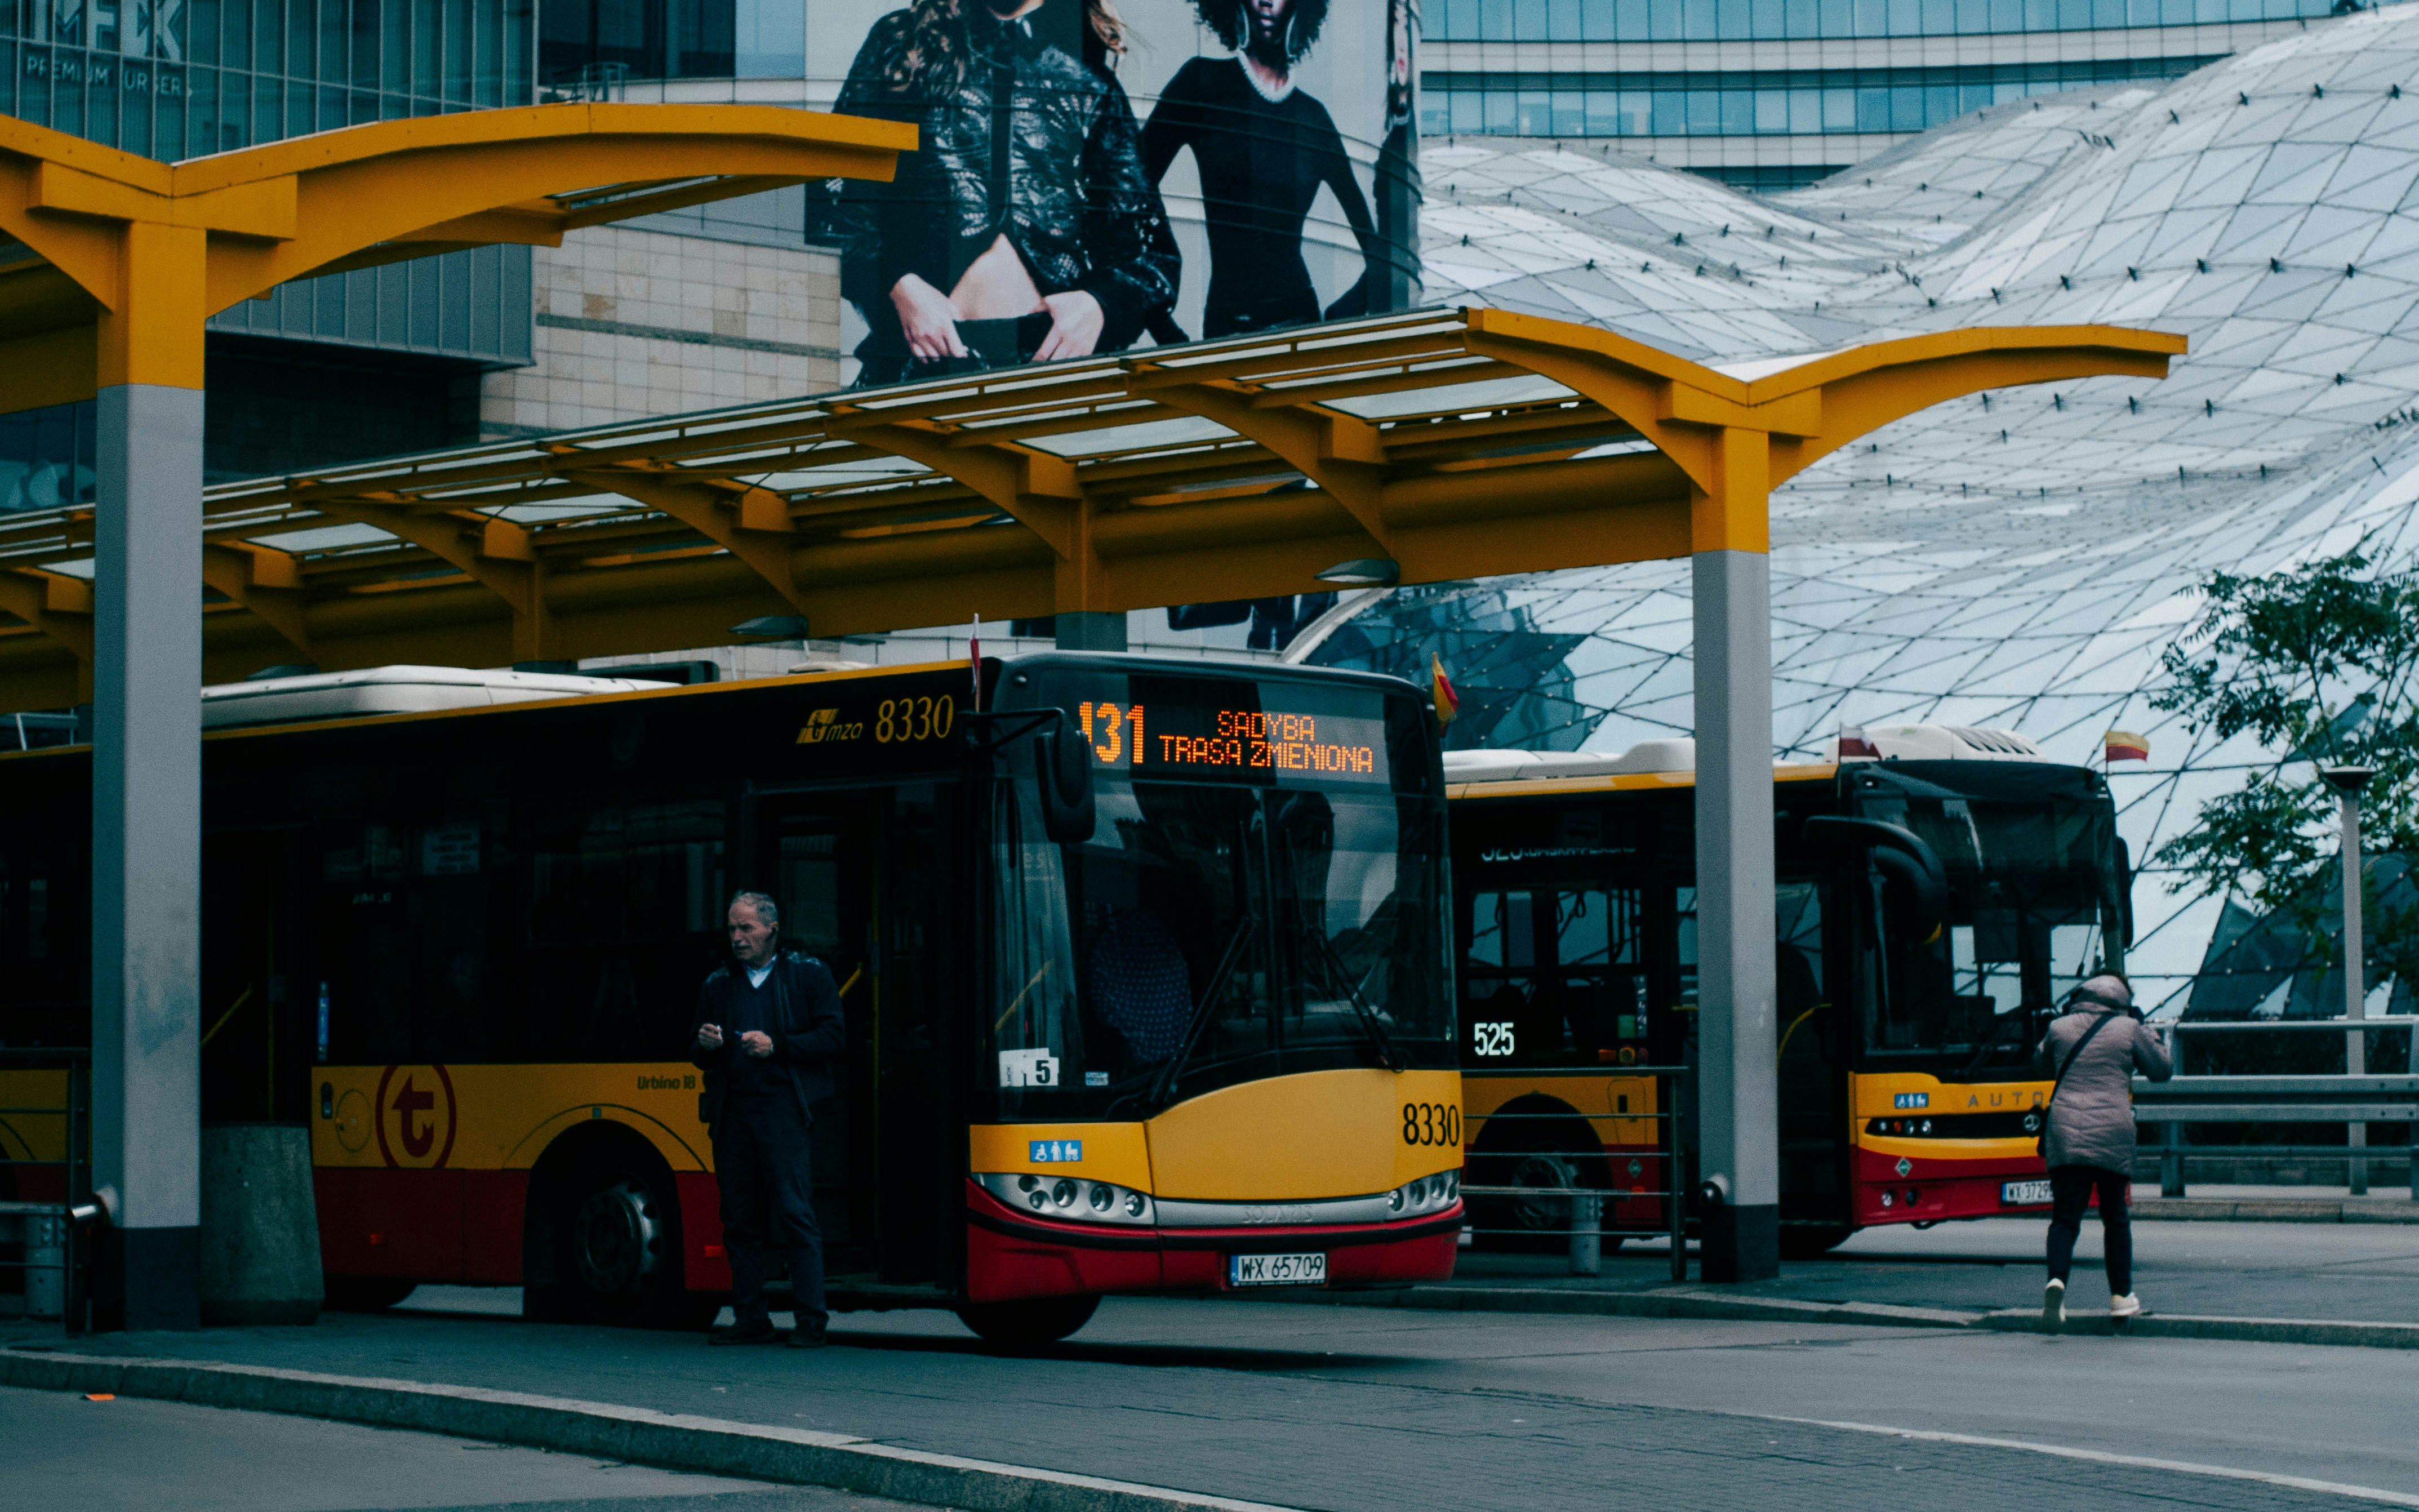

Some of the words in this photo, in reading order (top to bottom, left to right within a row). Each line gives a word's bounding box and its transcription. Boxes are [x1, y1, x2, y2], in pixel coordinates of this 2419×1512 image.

[875, 694, 954, 743] 8330
[1079, 701, 1144, 764] 131
[1217, 710, 1315, 742] SADYBA
[1158, 735, 1241, 766] TRASA
[1249, 742, 1373, 773] ZMIENIONA
[1474, 1022, 1514, 1056] 525
[637, 1074, 680, 1089] Urbino
[1035, 1059, 1051, 1084] 5
[1403, 1102, 1460, 1147] 8330
[2025, 1182, 2053, 1199] 3729
[1241, 1257, 1265, 1279] WX
[1271, 1255, 1323, 1278] 65709
